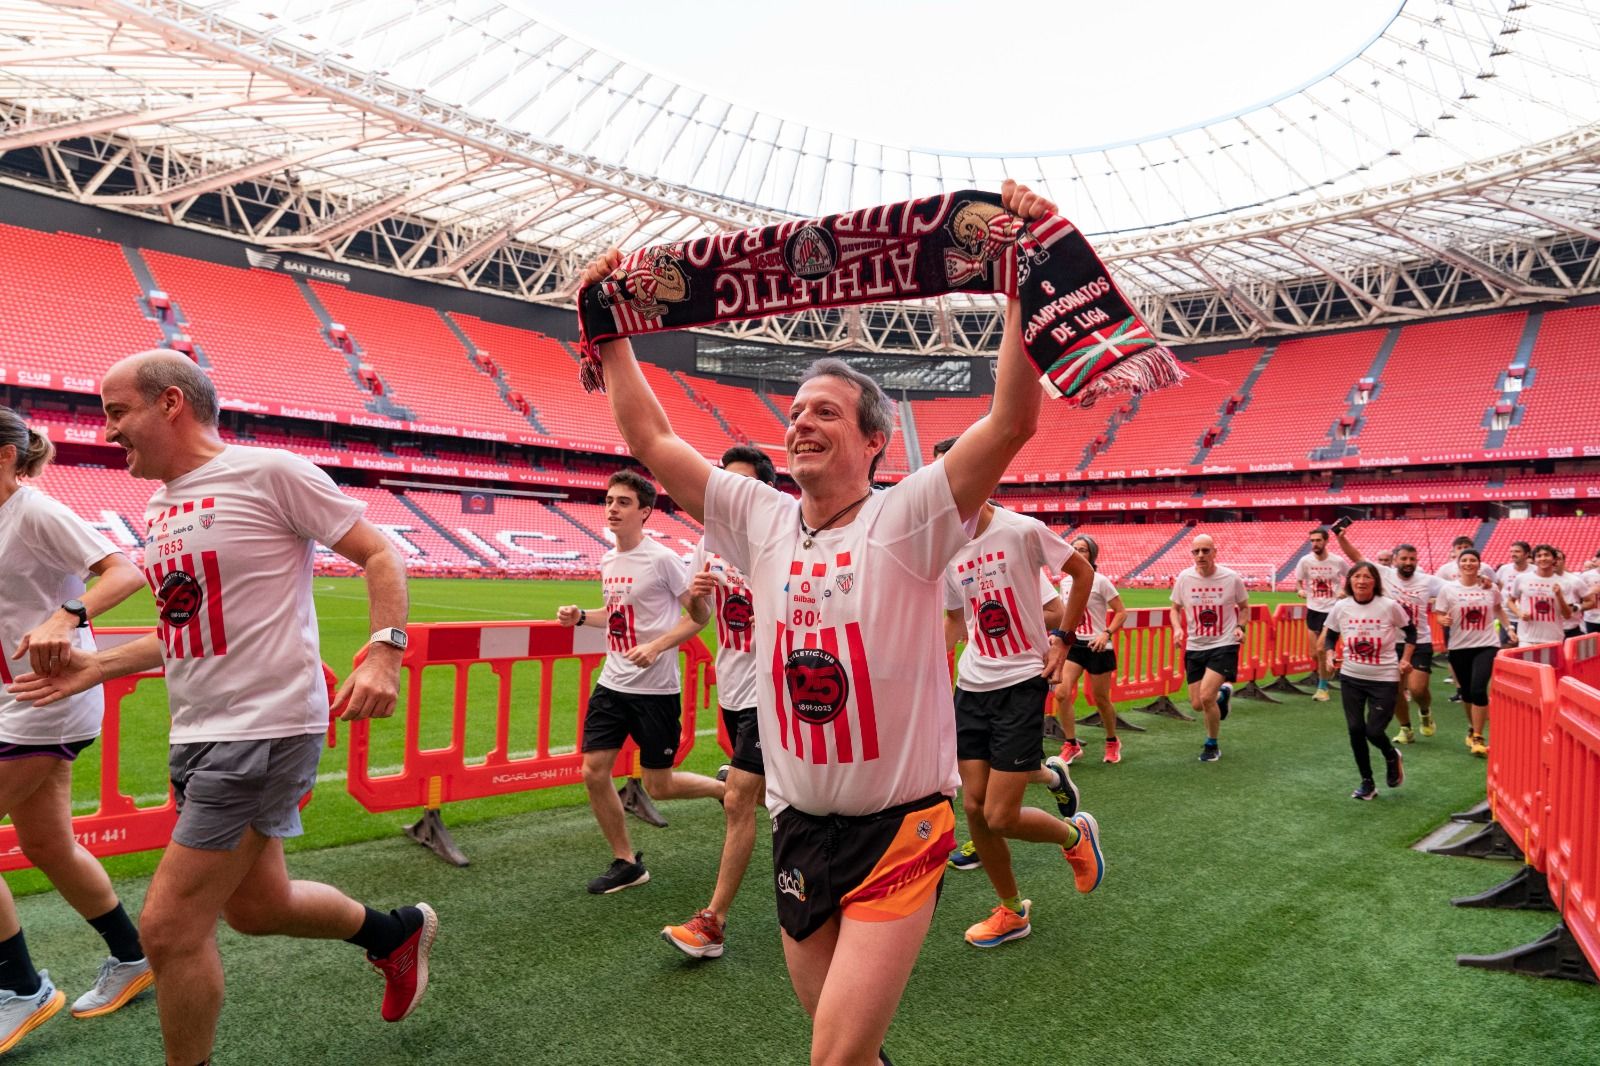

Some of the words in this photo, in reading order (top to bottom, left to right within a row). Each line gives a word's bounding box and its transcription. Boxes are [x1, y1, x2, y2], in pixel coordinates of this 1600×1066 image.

[284, 261, 307, 273] SAN
[310, 266, 351, 282] MAMES
[716, 242, 918, 315] ATHLETIC
[1041, 280, 1056, 296] 8
[1024, 276, 1111, 344] CAMPEONATOS
[1050, 322, 1077, 344] DE
[1074, 306, 1110, 330] LIGA
[17, 371, 51, 381] CLUB
[63, 376, 95, 387] CLUB
[281, 406, 338, 422] kutxabank
[351, 415, 402, 430] kutxabank
[410, 422, 458, 436] kutxabank
[65, 428, 96, 438] CLUB
[463, 429, 508, 442] kutxabank
[353, 457, 405, 472] kutxabank
[1360, 456, 1410, 466] kutxabank
[411, 463, 459, 477] kutxabank
[464, 468, 509, 481] kutxabank
[1131, 469, 1150, 477] IMQ
[1252, 498, 1297, 506] kutxabank
[1304, 495, 1352, 505] kutxabank
[1360, 493, 1409, 503] kutxabank
[1108, 502, 1126, 510] IMQ
[1130, 501, 1149, 509] IMQ
[158, 538, 184, 558] 7853
[793, 594, 816, 604] Bilbao
[559, 767, 573, 777] 711
[102, 828, 127, 843] 441
